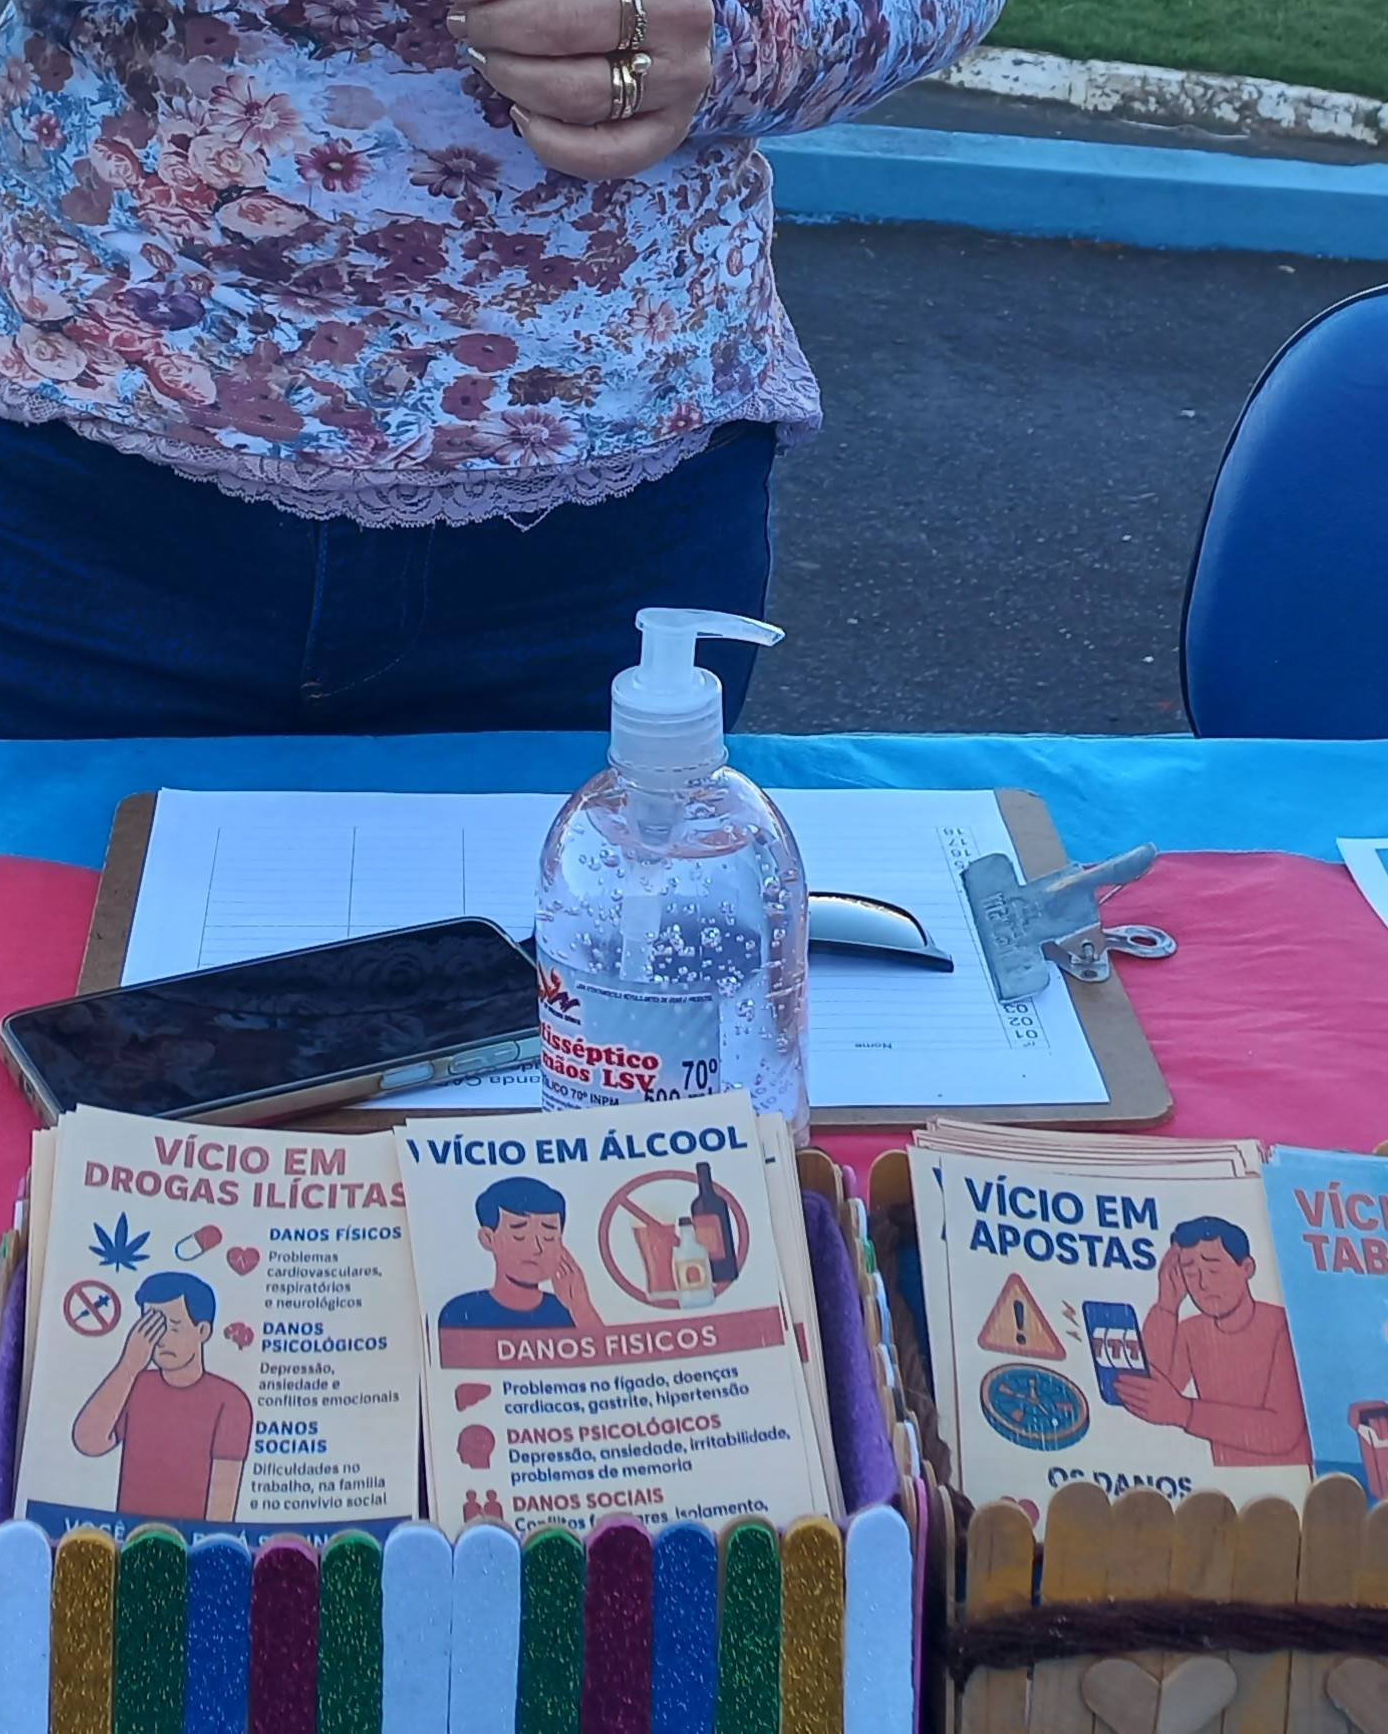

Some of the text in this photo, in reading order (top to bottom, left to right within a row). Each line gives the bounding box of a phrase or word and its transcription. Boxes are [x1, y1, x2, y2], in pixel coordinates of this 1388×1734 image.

[540, 1021, 659, 1070] tisséptico
[542, 1050, 657, 1092] mãos LSV
[154, 1134, 346, 1176] VÍCIO EM
[427, 1125, 748, 1166] VÍCIO EM ÁLCOOL
[84, 1161, 406, 1209] DROGAS ILÍCITAS
[965, 1175, 1159, 1231] VÍCIO EM
[269, 1225, 402, 1242] DANOS FÍSICOS
[970, 1219, 1158, 1271] APOSTAS
[268, 1250, 339, 1264] Problemas
[266, 1280, 351, 1295] respiratórios
[265, 1295, 362, 1312] e neurológicos
[262, 1321, 324, 1336] DANOS
[261, 1334, 388, 1354] PSICOLÓGICOS
[497, 1337, 596, 1362] DANOS
[260, 1362, 336, 1377] Depressão,
[258, 1378, 340, 1391] ansiedade e
[502, 1365, 739, 1396] Problemas no fígado, doenças
[257, 1390, 400, 1407] conflitos emocionais
[588, 1394, 653, 1413] gastrite,
[655, 1382, 750, 1406] hipertensão
[255, 1421, 319, 1436] DANOS
[507, 1413, 721, 1446] DANOS PSICOLÓGICOS
[254, 1439, 327, 1454] SOCIAIS
[508, 1426, 791, 1466] Depressão, ansiedade, irritabilidade,
[253, 1462, 361, 1477] Dificuldades no
[511, 1468, 594, 1486] problemas
[597, 1465, 619, 1480] de
[251, 1480, 315, 1495] trabalho,
[317, 1481, 335, 1492] na
[250, 1500, 258, 1510] e
[261, 1499, 280, 1510] no
[346, 1492, 388, 1507] social
[512, 1488, 664, 1513] DANOS SOCIAIS
